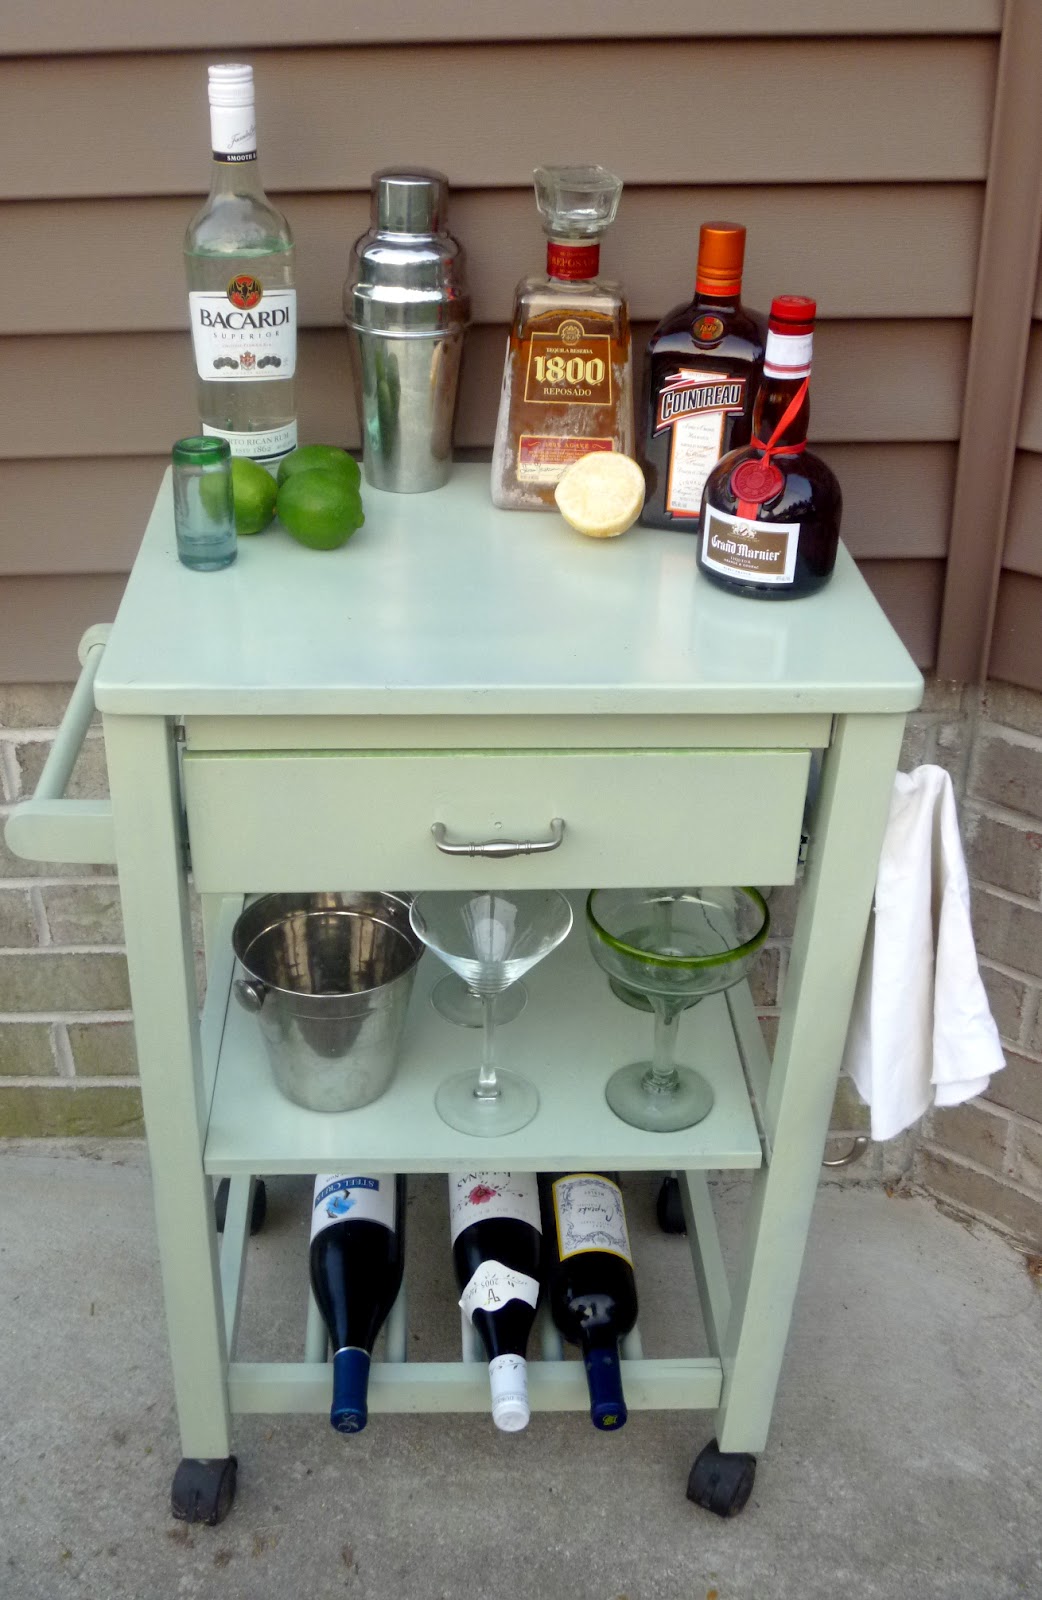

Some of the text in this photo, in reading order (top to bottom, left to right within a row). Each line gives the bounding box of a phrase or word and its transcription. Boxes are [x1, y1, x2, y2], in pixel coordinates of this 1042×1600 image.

[226, 153, 252, 162] SMOOTH
[199, 306, 290, 331] BACARDI
[213, 330, 280, 340] SUPERIOR
[569, 347, 593, 355] RESERVA
[534, 355, 606, 387] 1800
[543, 387, 592, 398] REPOSADO
[661, 383, 741, 421] COINTREAU
[229, 438, 245, 446] RTO
[246, 436, 273, 446] RICAN
[274, 432, 289, 443] RUM
[253, 446, 272, 454] 1862
[711, 534, 736, 554] Grand
[737, 543, 780, 562] Marnier
[345, 1179, 375, 1187] STEEL
[578, 1204, 614, 1223] Cupcake
